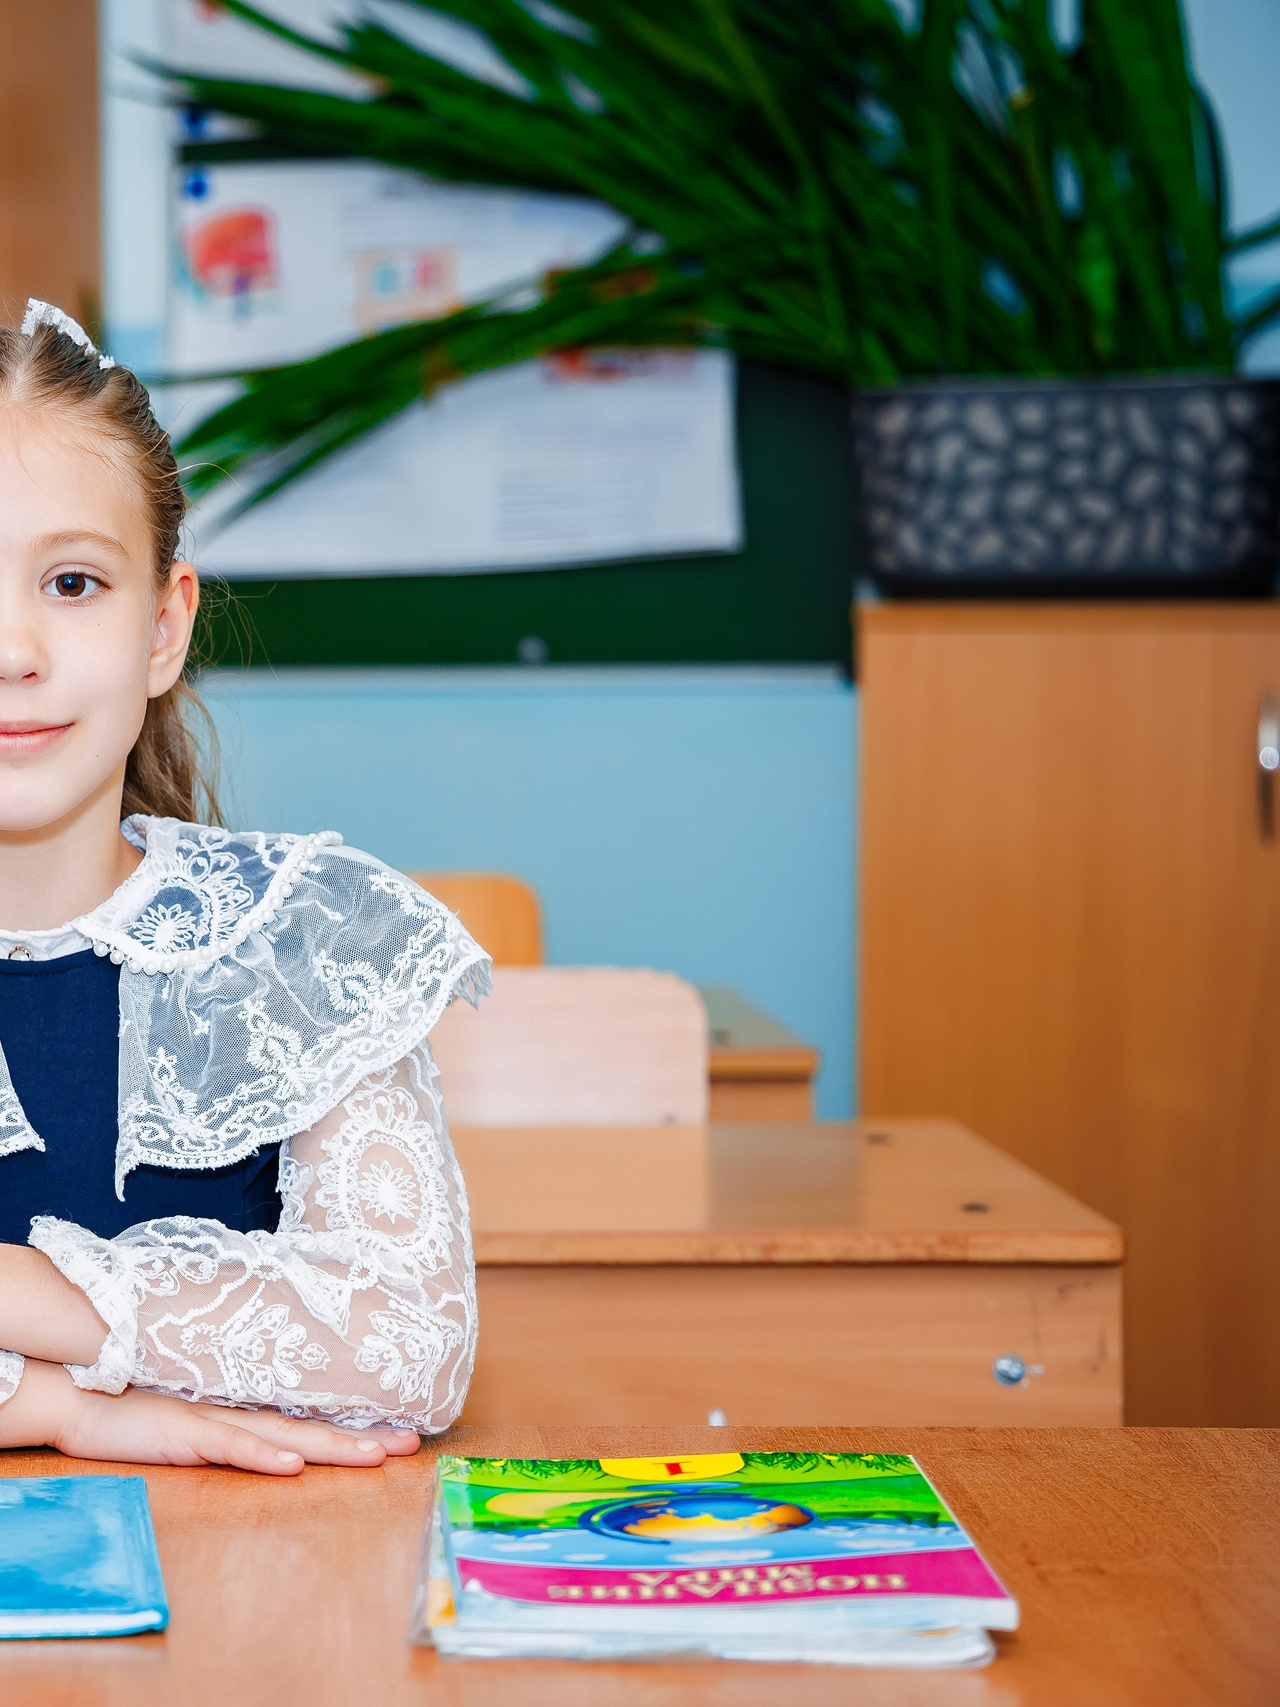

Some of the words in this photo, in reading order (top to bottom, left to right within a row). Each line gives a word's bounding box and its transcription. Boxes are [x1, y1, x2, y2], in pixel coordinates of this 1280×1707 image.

[650, 1461, 697, 1476] 1
[547, 1573, 905, 1599] ПОЗНАНИЕ
[627, 1564, 812, 1587] МИРА
